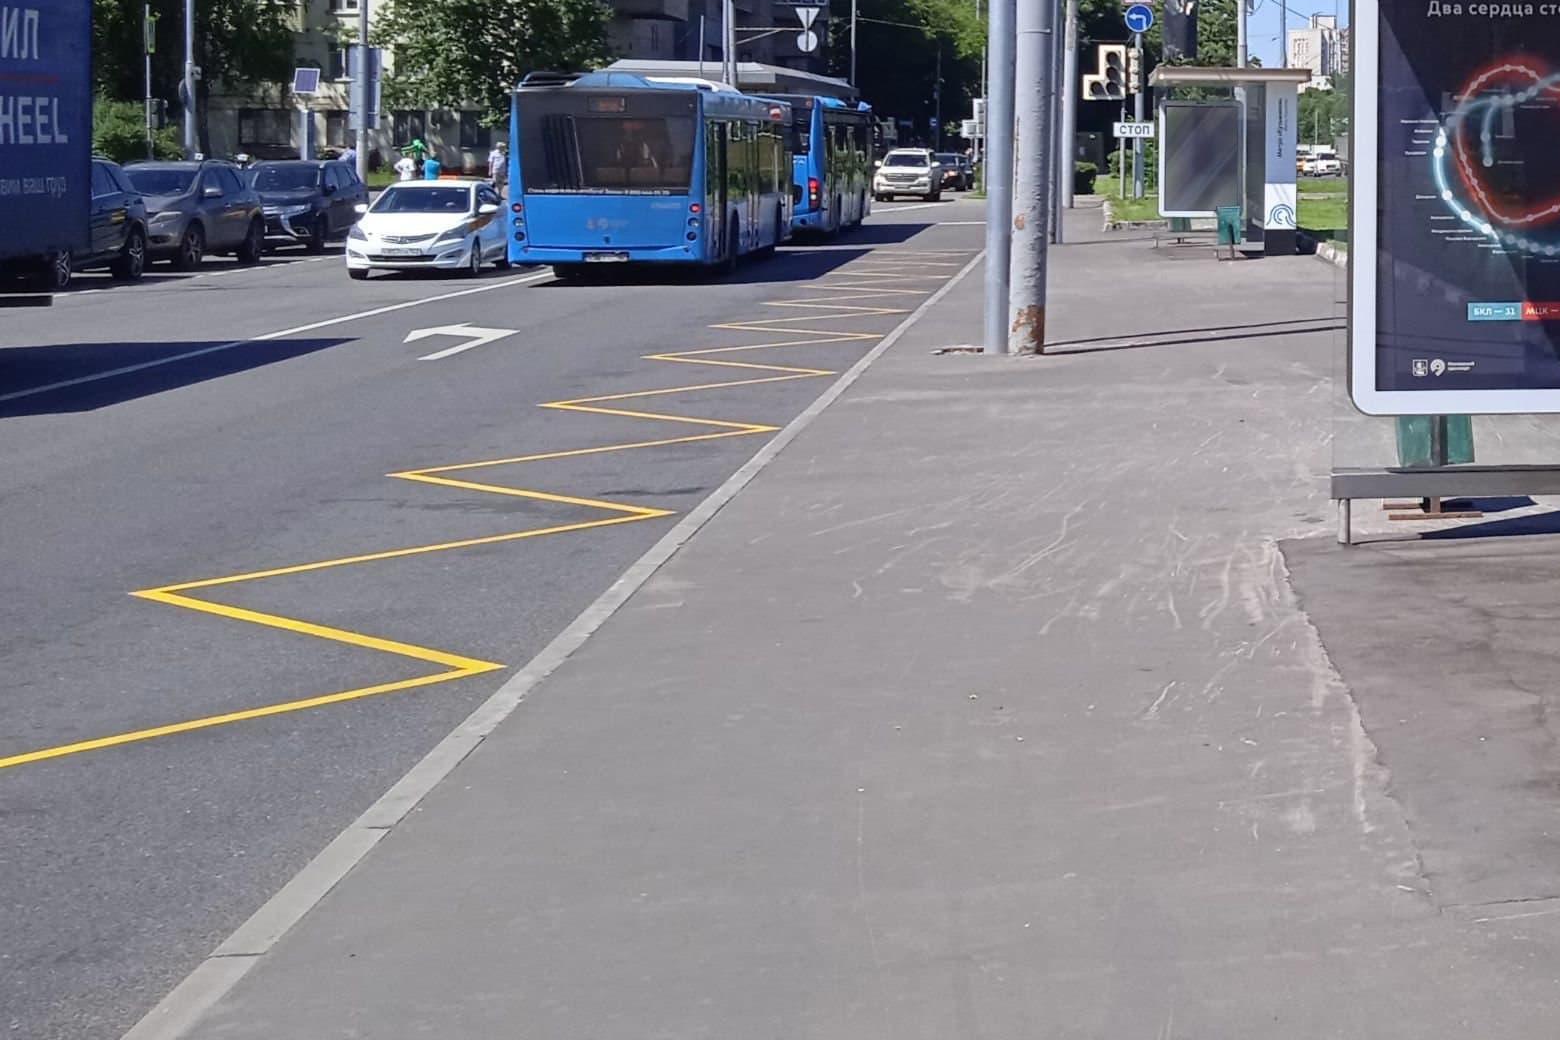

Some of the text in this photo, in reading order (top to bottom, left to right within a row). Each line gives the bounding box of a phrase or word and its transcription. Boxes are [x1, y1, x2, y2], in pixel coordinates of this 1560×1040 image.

[1427, 0, 1463, 17] Два
[1468, 2, 1534, 17] сердца
[1119, 125, 1150, 135] СТОП
